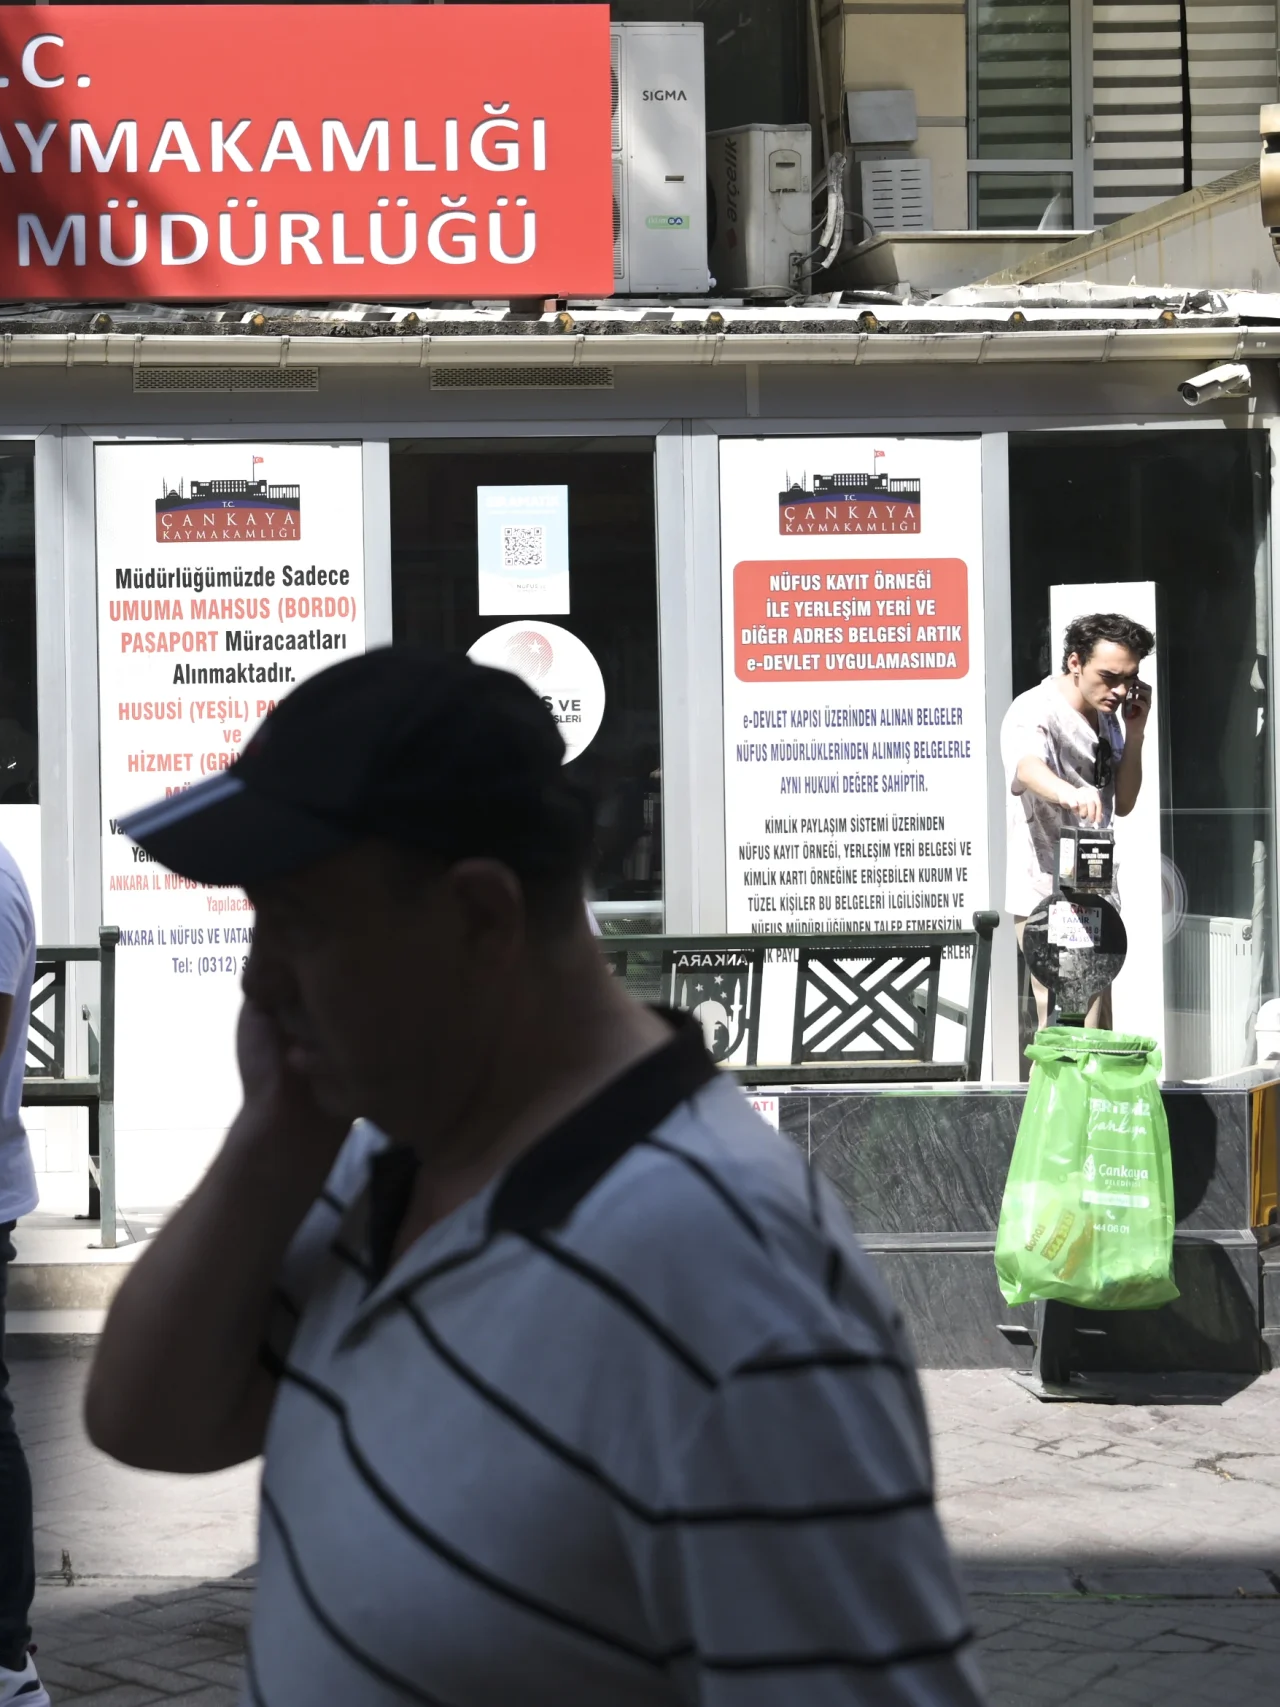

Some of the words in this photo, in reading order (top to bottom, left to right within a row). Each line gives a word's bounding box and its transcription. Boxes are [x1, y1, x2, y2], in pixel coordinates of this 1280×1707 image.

[642, 90, 687, 101] SIGMA
[726, 137, 740, 223] arçelik
[18, 196, 536, 266] MÜDÜRLÜĞÜ
[161, 512, 294, 530] ÇANKAYA
[784, 505, 914, 524] ÇANKAYA
[163, 528, 296, 541] KAYMAKAMLIĞI
[785, 520, 916, 532] KAYMAKAMLIĞI
[115, 566, 275, 593] Müdürlüğümüzde
[282, 564, 350, 587] Sadece
[769, 571, 821, 591] NÜFUS
[826, 574, 869, 590] KAYIT
[874, 569, 931, 590] ÖRNEĞİ
[109, 599, 184, 622] UMUMA
[190, 597, 270, 620] MAHSUS
[278, 596, 356, 623] (BORDO)
[766, 598, 790, 618] İLE
[794, 597, 871, 621] YERLEŞİM
[875, 596, 911, 616] YERİ
[915, 599, 936, 616] VE
[121, 631, 218, 653] PASAPORT
[225, 629, 346, 651] Müracaatları
[741, 624, 788, 644] DİĞER
[792, 627, 844, 644] ADRES
[848, 622, 911, 643] BELGESİ
[916, 625, 962, 642] ARTIK
[746, 654, 821, 671] e-DEVLET
[825, 652, 957, 670] UYGULAMASINDA
[172, 662, 295, 684] Alınmaktadır.
[118, 697, 182, 720] HUSUSİ
[189, 696, 249, 724] (YEŞİL)
[558, 700, 581, 712] VE
[743, 710, 787, 728] e-DEVLET
[790, 709, 821, 728] KAPISI
[824, 705, 877, 727] ÜZERİNDEN
[880, 708, 913, 726] ALINAN
[916, 707, 963, 726] BELGELER
[223, 730, 242, 744] ve
[127, 750, 193, 772] HİZMET
[736, 740, 768, 762] NÜFUS
[770, 738, 869, 761] MÜDÜRLÜKLERİNDEN
[872, 741, 910, 764] ALINMIŞ
[913, 740, 970, 759] BELGELERLE
[780, 776, 801, 794] AYNI
[804, 771, 839, 794] HUKUKİ
[842, 771, 879, 793] DEĞERE
[881, 770, 928, 793] SAHİPTİR.
[765, 815, 798, 834] KİMLİK
[800, 817, 847, 836] PAYLAŞIM
[850, 814, 888, 832] SİSTEMİ
[892, 813, 944, 832] ÜZERİNDEN
[738, 842, 770, 860] NÜFUS
[773, 844, 800, 860] KAYIT
[802, 841, 840, 859] ÖRNEĞİ,
[843, 842, 891, 861] YERLEŞİM
[893, 839, 915, 857] YERİ
[918, 841, 957, 856] BELGESİ
[959, 841, 972, 856] VE
[109, 874, 149, 891] ANKARA
[152, 874, 161, 890] İL
[744, 867, 777, 886] KİMLİK
[779, 870, 807, 885] KARTI
[810, 866, 858, 885] ÖRNEĞİNE
[860, 866, 915, 887] ERİŞEBİLEN
[918, 867, 953, 882] KURUM
[955, 867, 968, 882] VE
[748, 894, 776, 912] TÜZEL
[780, 893, 816, 915] KİŞİLER
[819, 896, 832, 910] BU
[835, 891, 885, 910] BELGELERİ
[888, 890, 949, 909] İLGİLİSİNDEN
[952, 892, 964, 908] VE
[157, 926, 167, 945] İL
[170, 925, 204, 945] NÜFUS
[207, 928, 220, 944] VE
[171, 957, 192, 973] Tel:
[197, 956, 237, 976] (0312)
[1098, 1164, 1149, 1180] Çankaya
